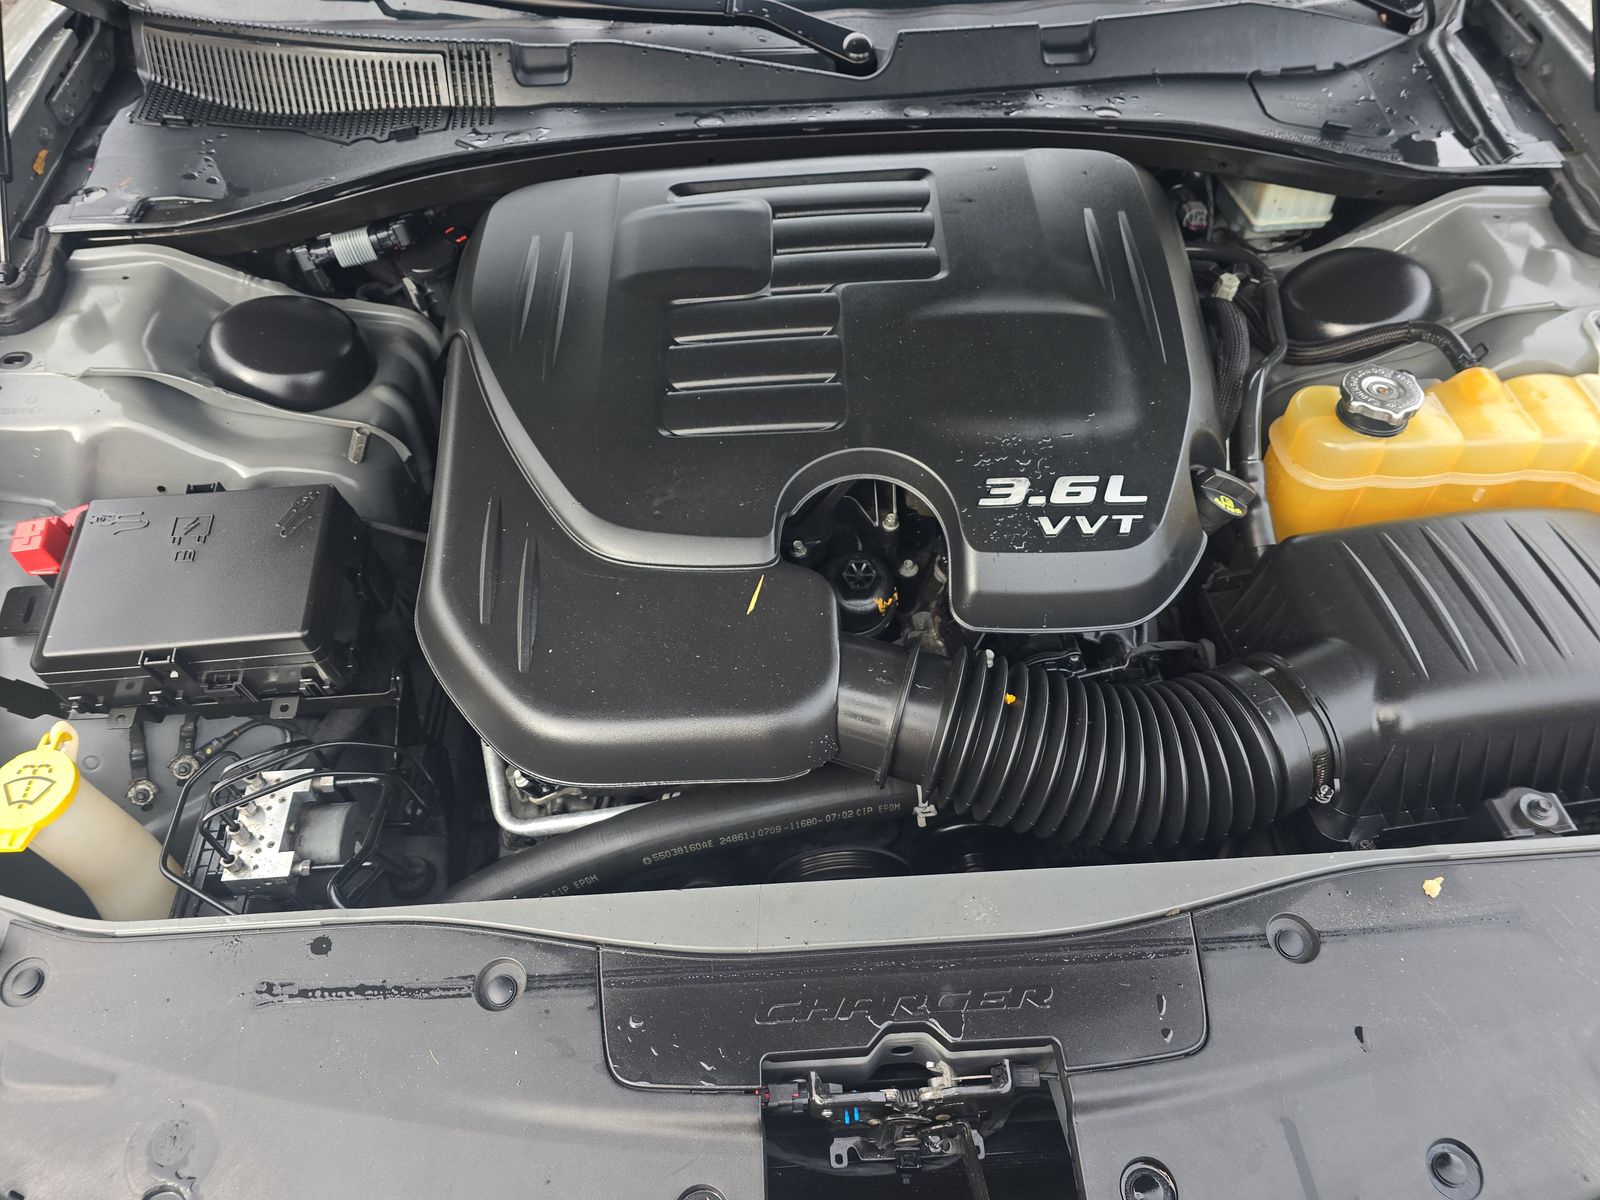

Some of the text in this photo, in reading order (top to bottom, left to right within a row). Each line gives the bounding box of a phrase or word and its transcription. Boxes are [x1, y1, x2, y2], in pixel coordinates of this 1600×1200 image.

[978, 474, 1148, 507] 3.6L
[1037, 514, 1145, 537] VVT
[572, 874, 599, 889] EPDM
[755, 987, 1054, 1025] CHARGER
